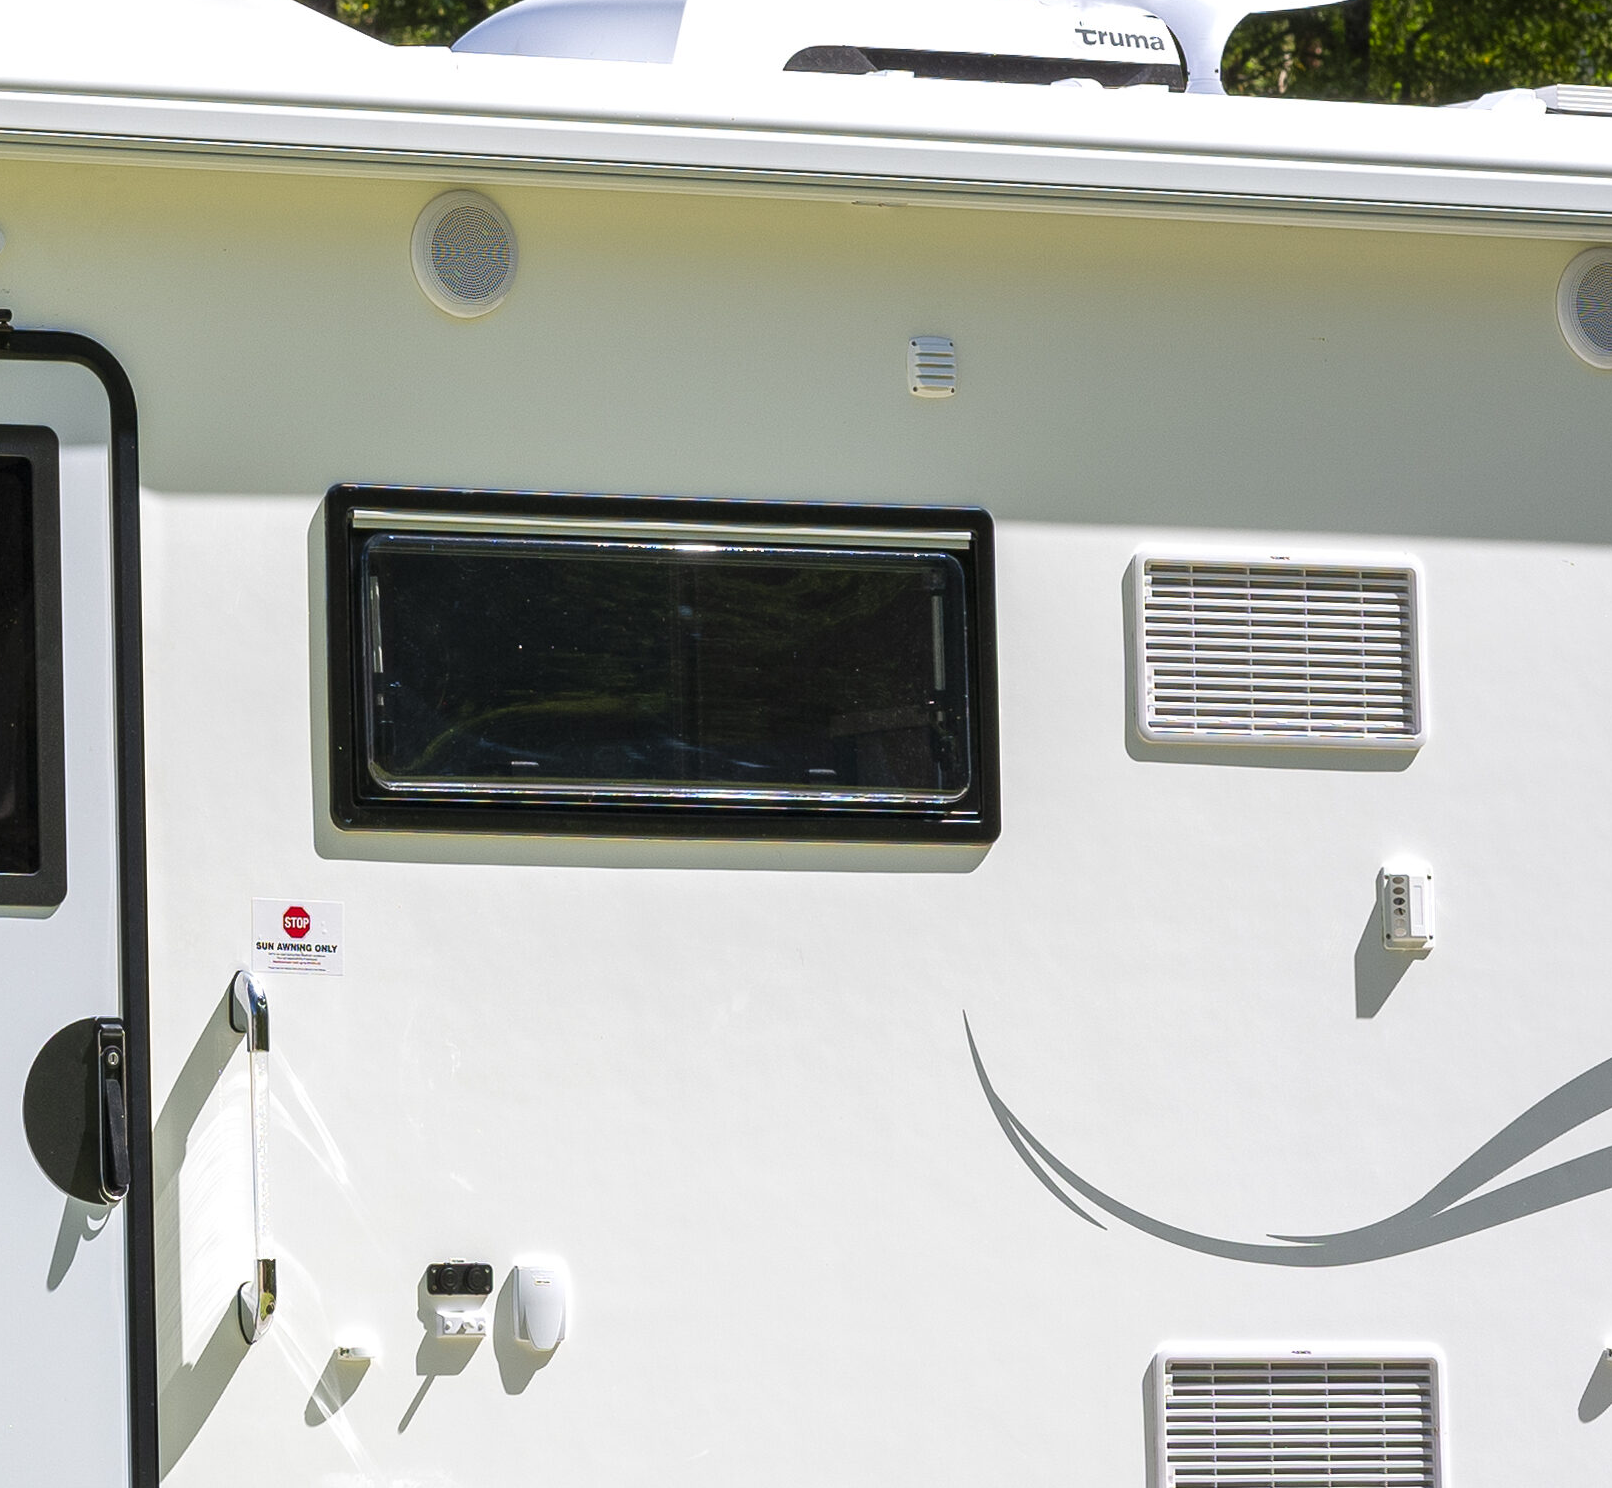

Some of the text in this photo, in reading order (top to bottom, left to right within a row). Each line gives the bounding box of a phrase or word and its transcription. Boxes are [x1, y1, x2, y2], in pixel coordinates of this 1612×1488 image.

[284, 916, 309, 929] STOP
[256, 941, 338, 954] SUN AWNING ONLY
